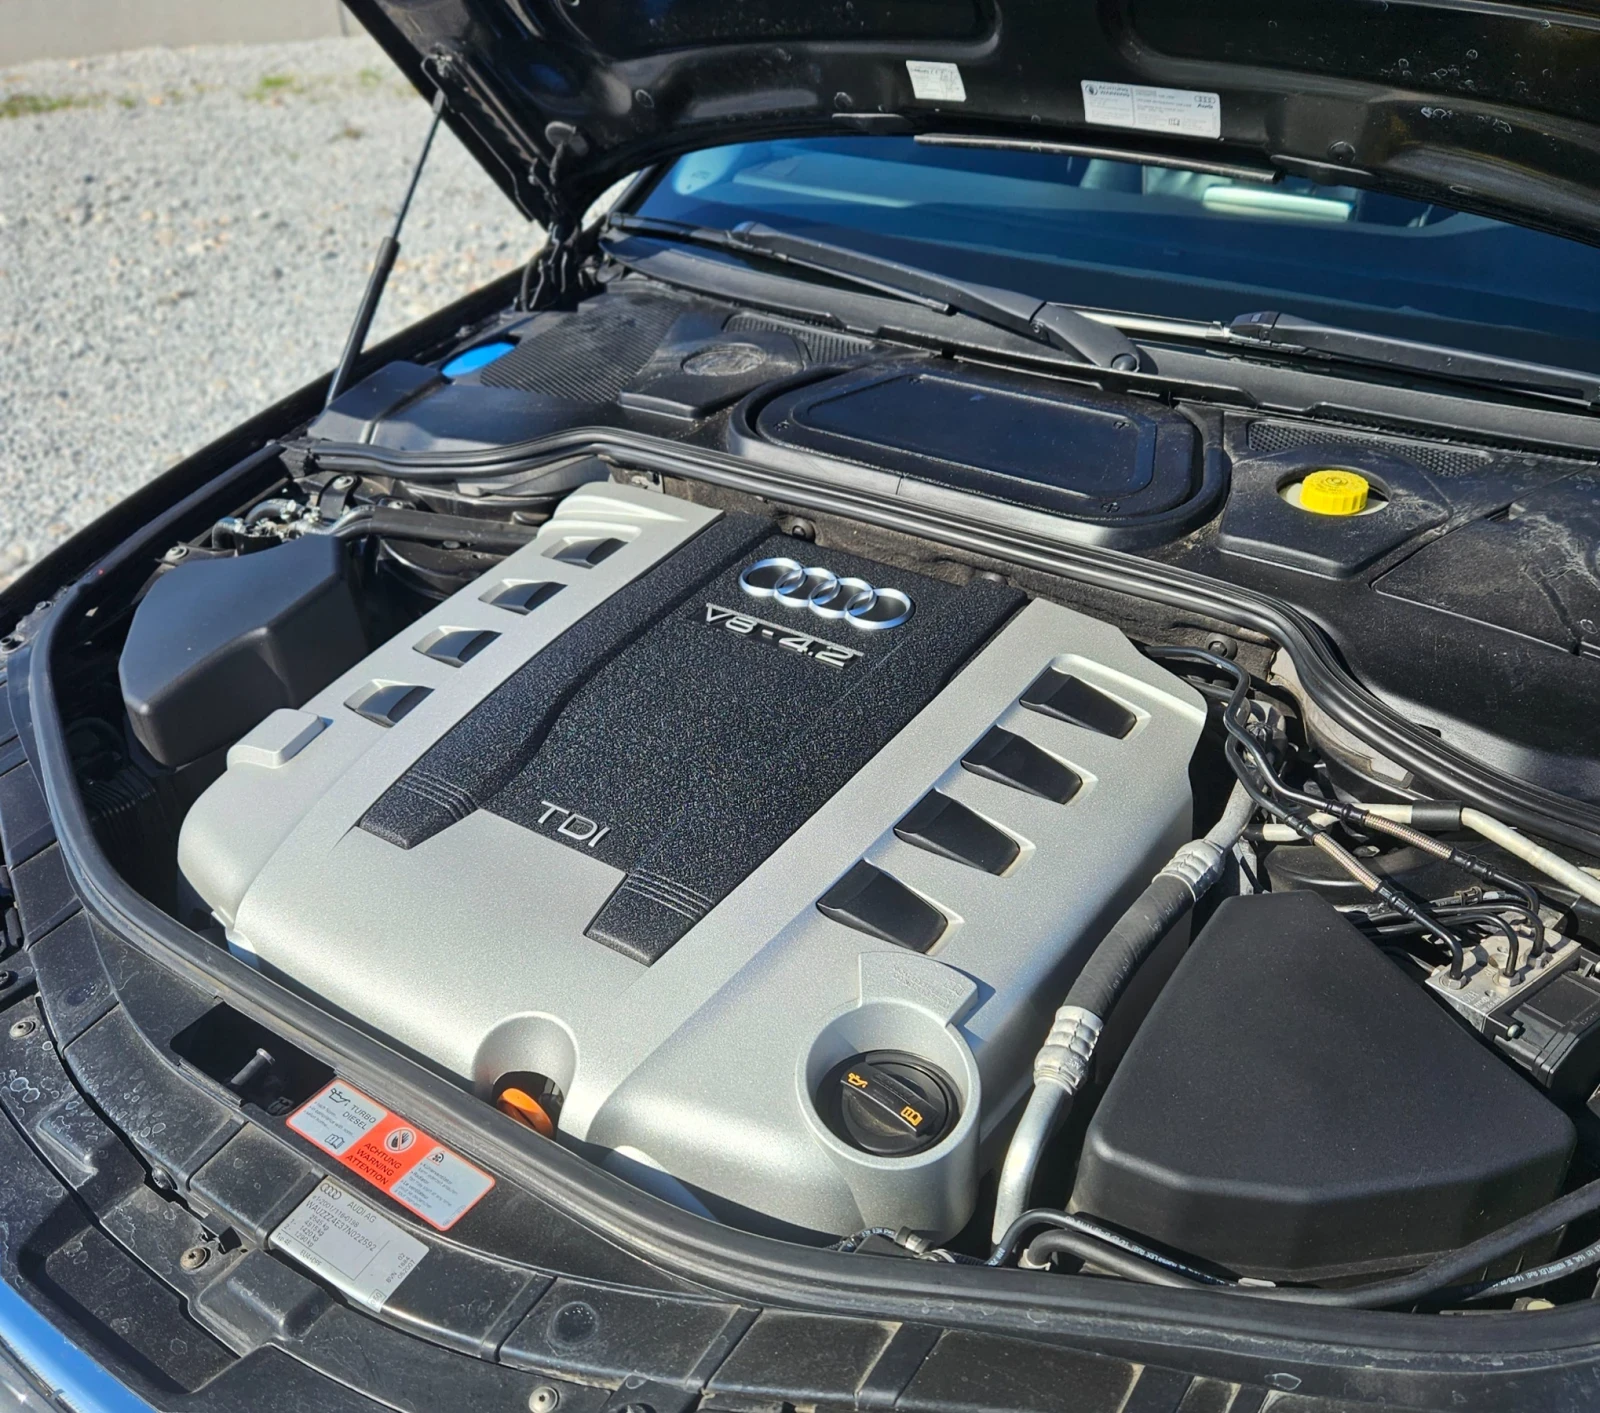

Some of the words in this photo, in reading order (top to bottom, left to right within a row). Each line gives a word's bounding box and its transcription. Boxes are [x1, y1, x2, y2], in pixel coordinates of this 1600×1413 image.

[538, 801, 610, 847] TDI
[341, 1111, 369, 1129] DIESEL
[348, 1104, 377, 1123] TURBO
[356, 1149, 394, 1176] WARNING
[364, 1143, 402, 1169] ACHTUNG
[346, 1155, 388, 1185] ATTENTION
[346, 1200, 366, 1216] AUDI
[363, 1212, 377, 1223] AG
[298, 1224, 314, 1237] 1420
[310, 1233, 320, 1242] kg
[303, 1199, 378, 1251] WAUZZZ4E37N022592
[315, 1228, 325, 1236] kg
[320, 1222, 331, 1231] kg
[305, 1238, 315, 1248] kg
